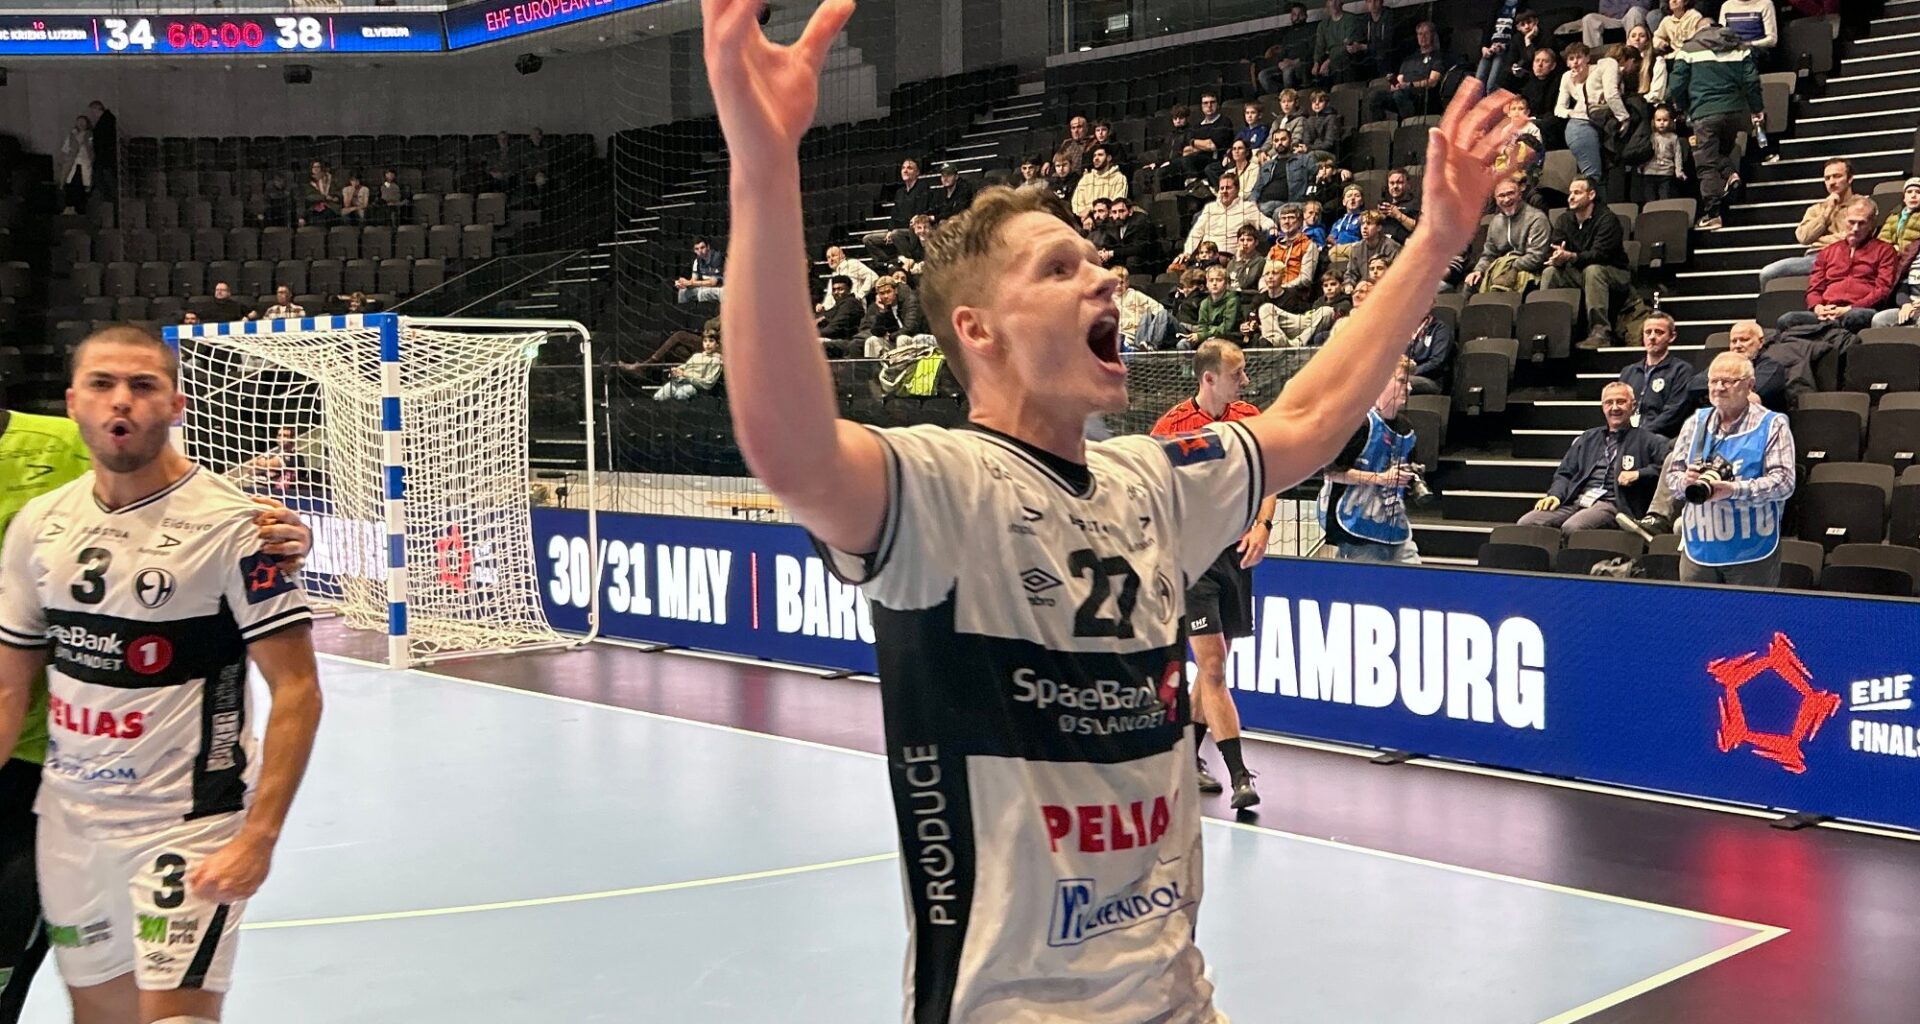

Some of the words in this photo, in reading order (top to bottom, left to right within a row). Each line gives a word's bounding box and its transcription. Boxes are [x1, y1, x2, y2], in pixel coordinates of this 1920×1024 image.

[48, 30, 87, 40] LUZERN
[104, 18, 155, 50] 34
[167, 22, 263, 48] 60:00
[275, 17, 323, 49] 38
[361, 27, 410, 38] ELVERUM
[486, 9, 511, 31] EHF
[1685, 500, 1776, 542] PHOTO
[70, 547, 112, 605] 3
[548, 534, 652, 616] 30/31
[657, 543, 732, 625] MAY
[1067, 548, 1140, 639] 27
[1191, 616, 1208, 631] EHF
[140, 641, 158, 667] 1
[1851, 674, 1913, 705] EHF
[903, 743, 957, 925] PRODUCE
[1040, 789, 1179, 853] PELIA
[153, 853, 186, 909] 3
